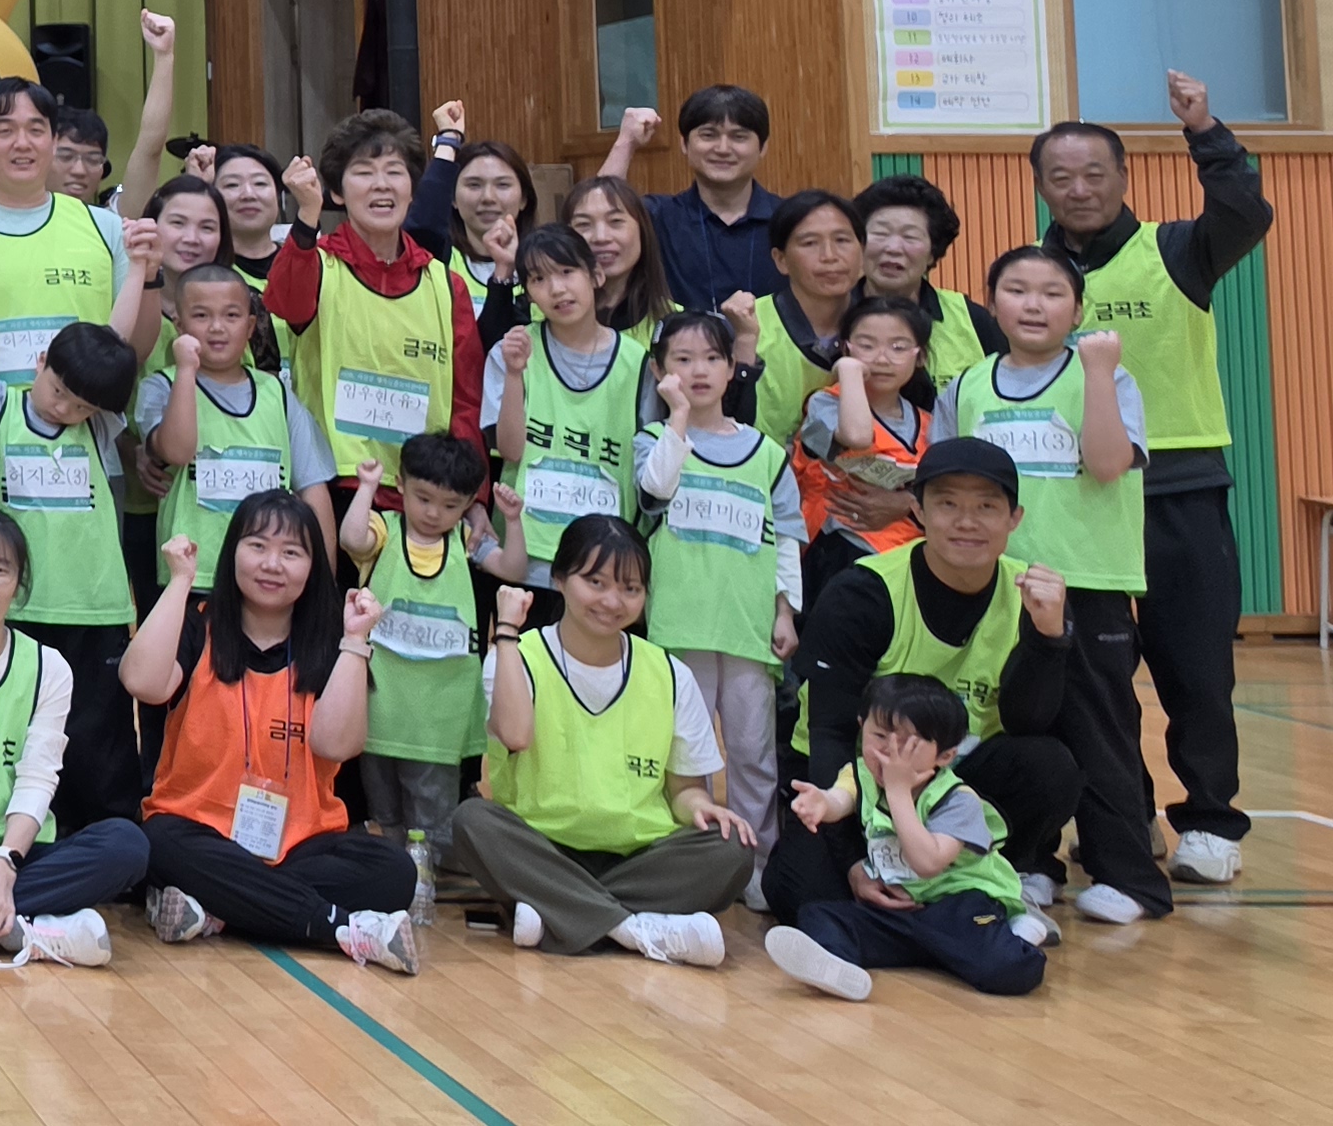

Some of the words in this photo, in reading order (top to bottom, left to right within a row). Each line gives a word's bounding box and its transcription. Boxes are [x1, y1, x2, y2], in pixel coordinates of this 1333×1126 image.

[44, 268, 92, 286] 금곡초
[1095, 301, 1153, 322] 금곡초
[526, 417, 622, 466] 금곡초
